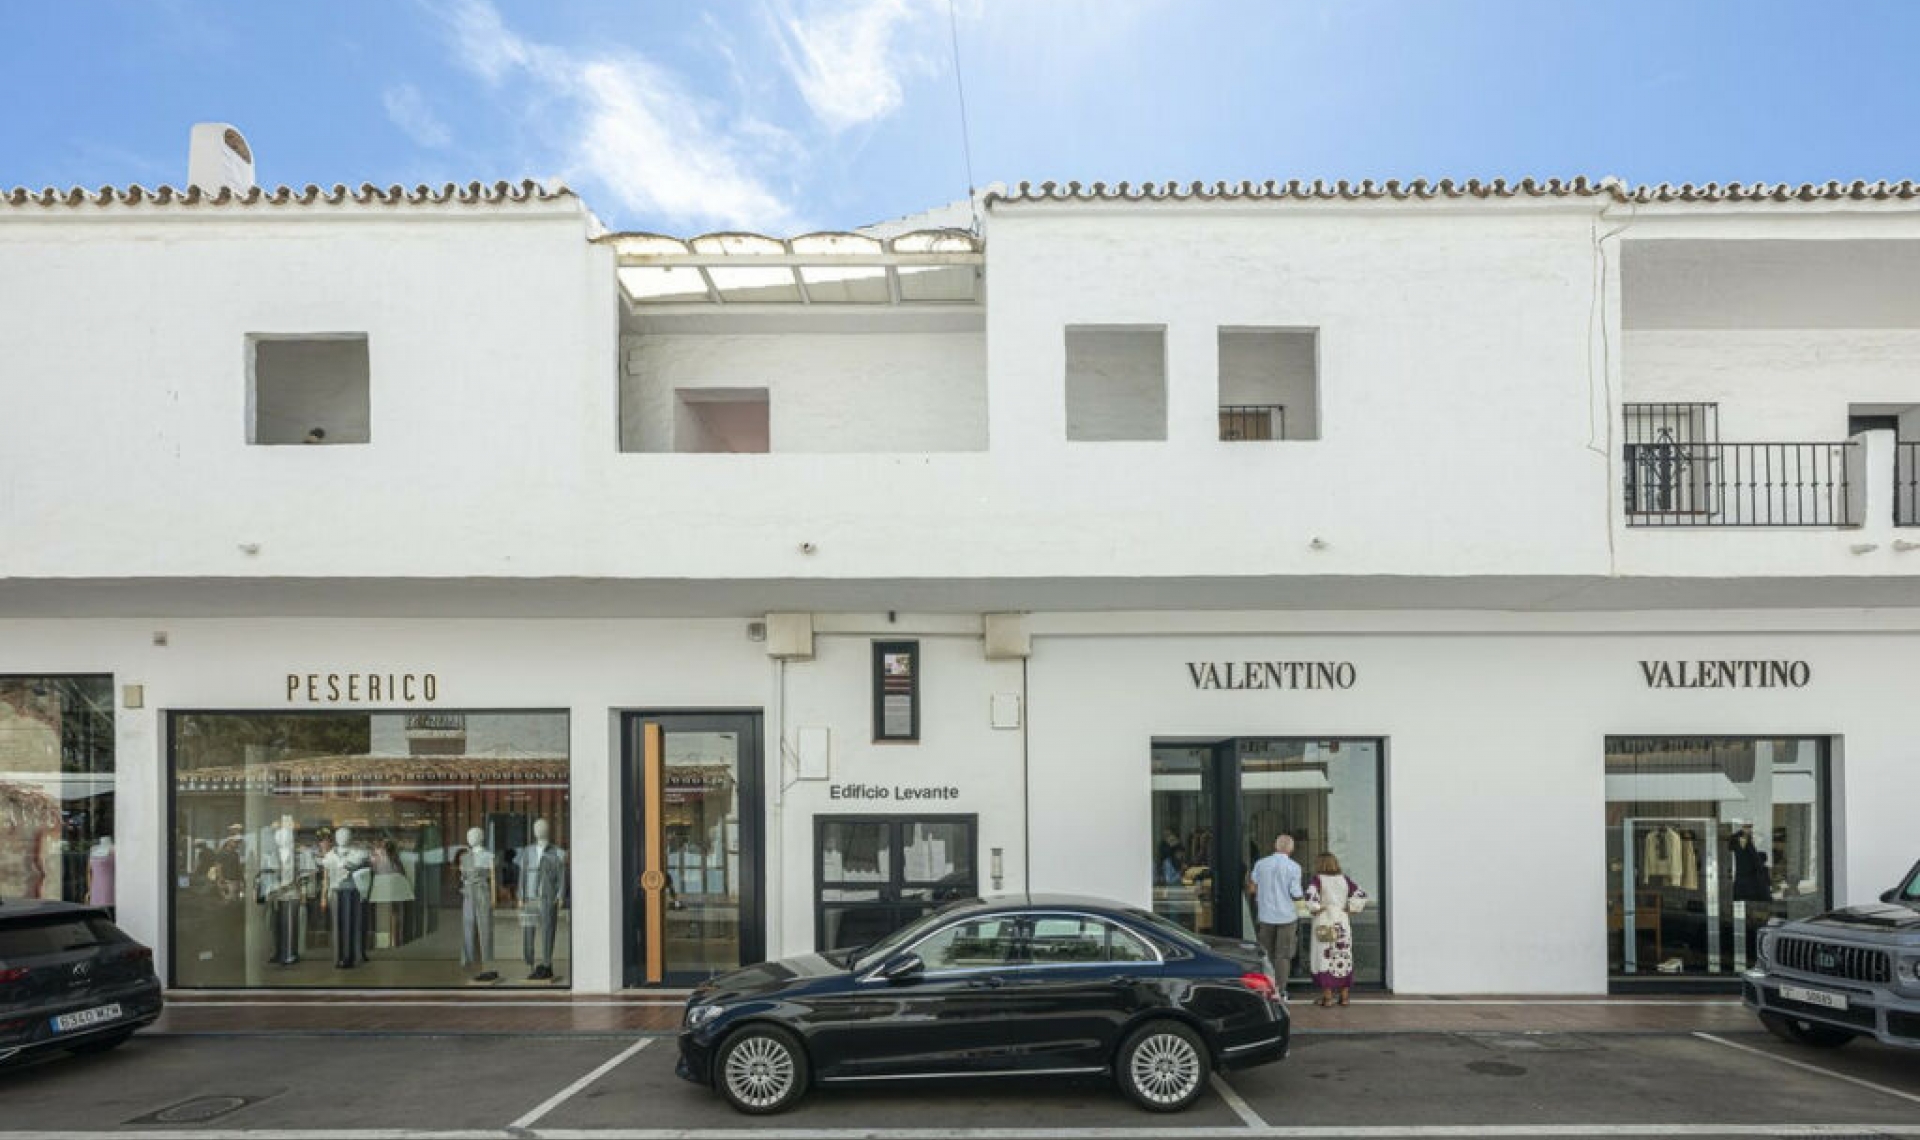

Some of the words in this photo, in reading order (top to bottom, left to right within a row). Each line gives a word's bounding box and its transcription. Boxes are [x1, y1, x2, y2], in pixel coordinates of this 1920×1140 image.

[287, 673, 436, 701] PESERICO
[1185, 661, 1356, 690] VALENTINO
[1637, 660, 1810, 688] VALENTINO
[830, 784, 889, 800] Edificio
[895, 786, 959, 800] Levante
